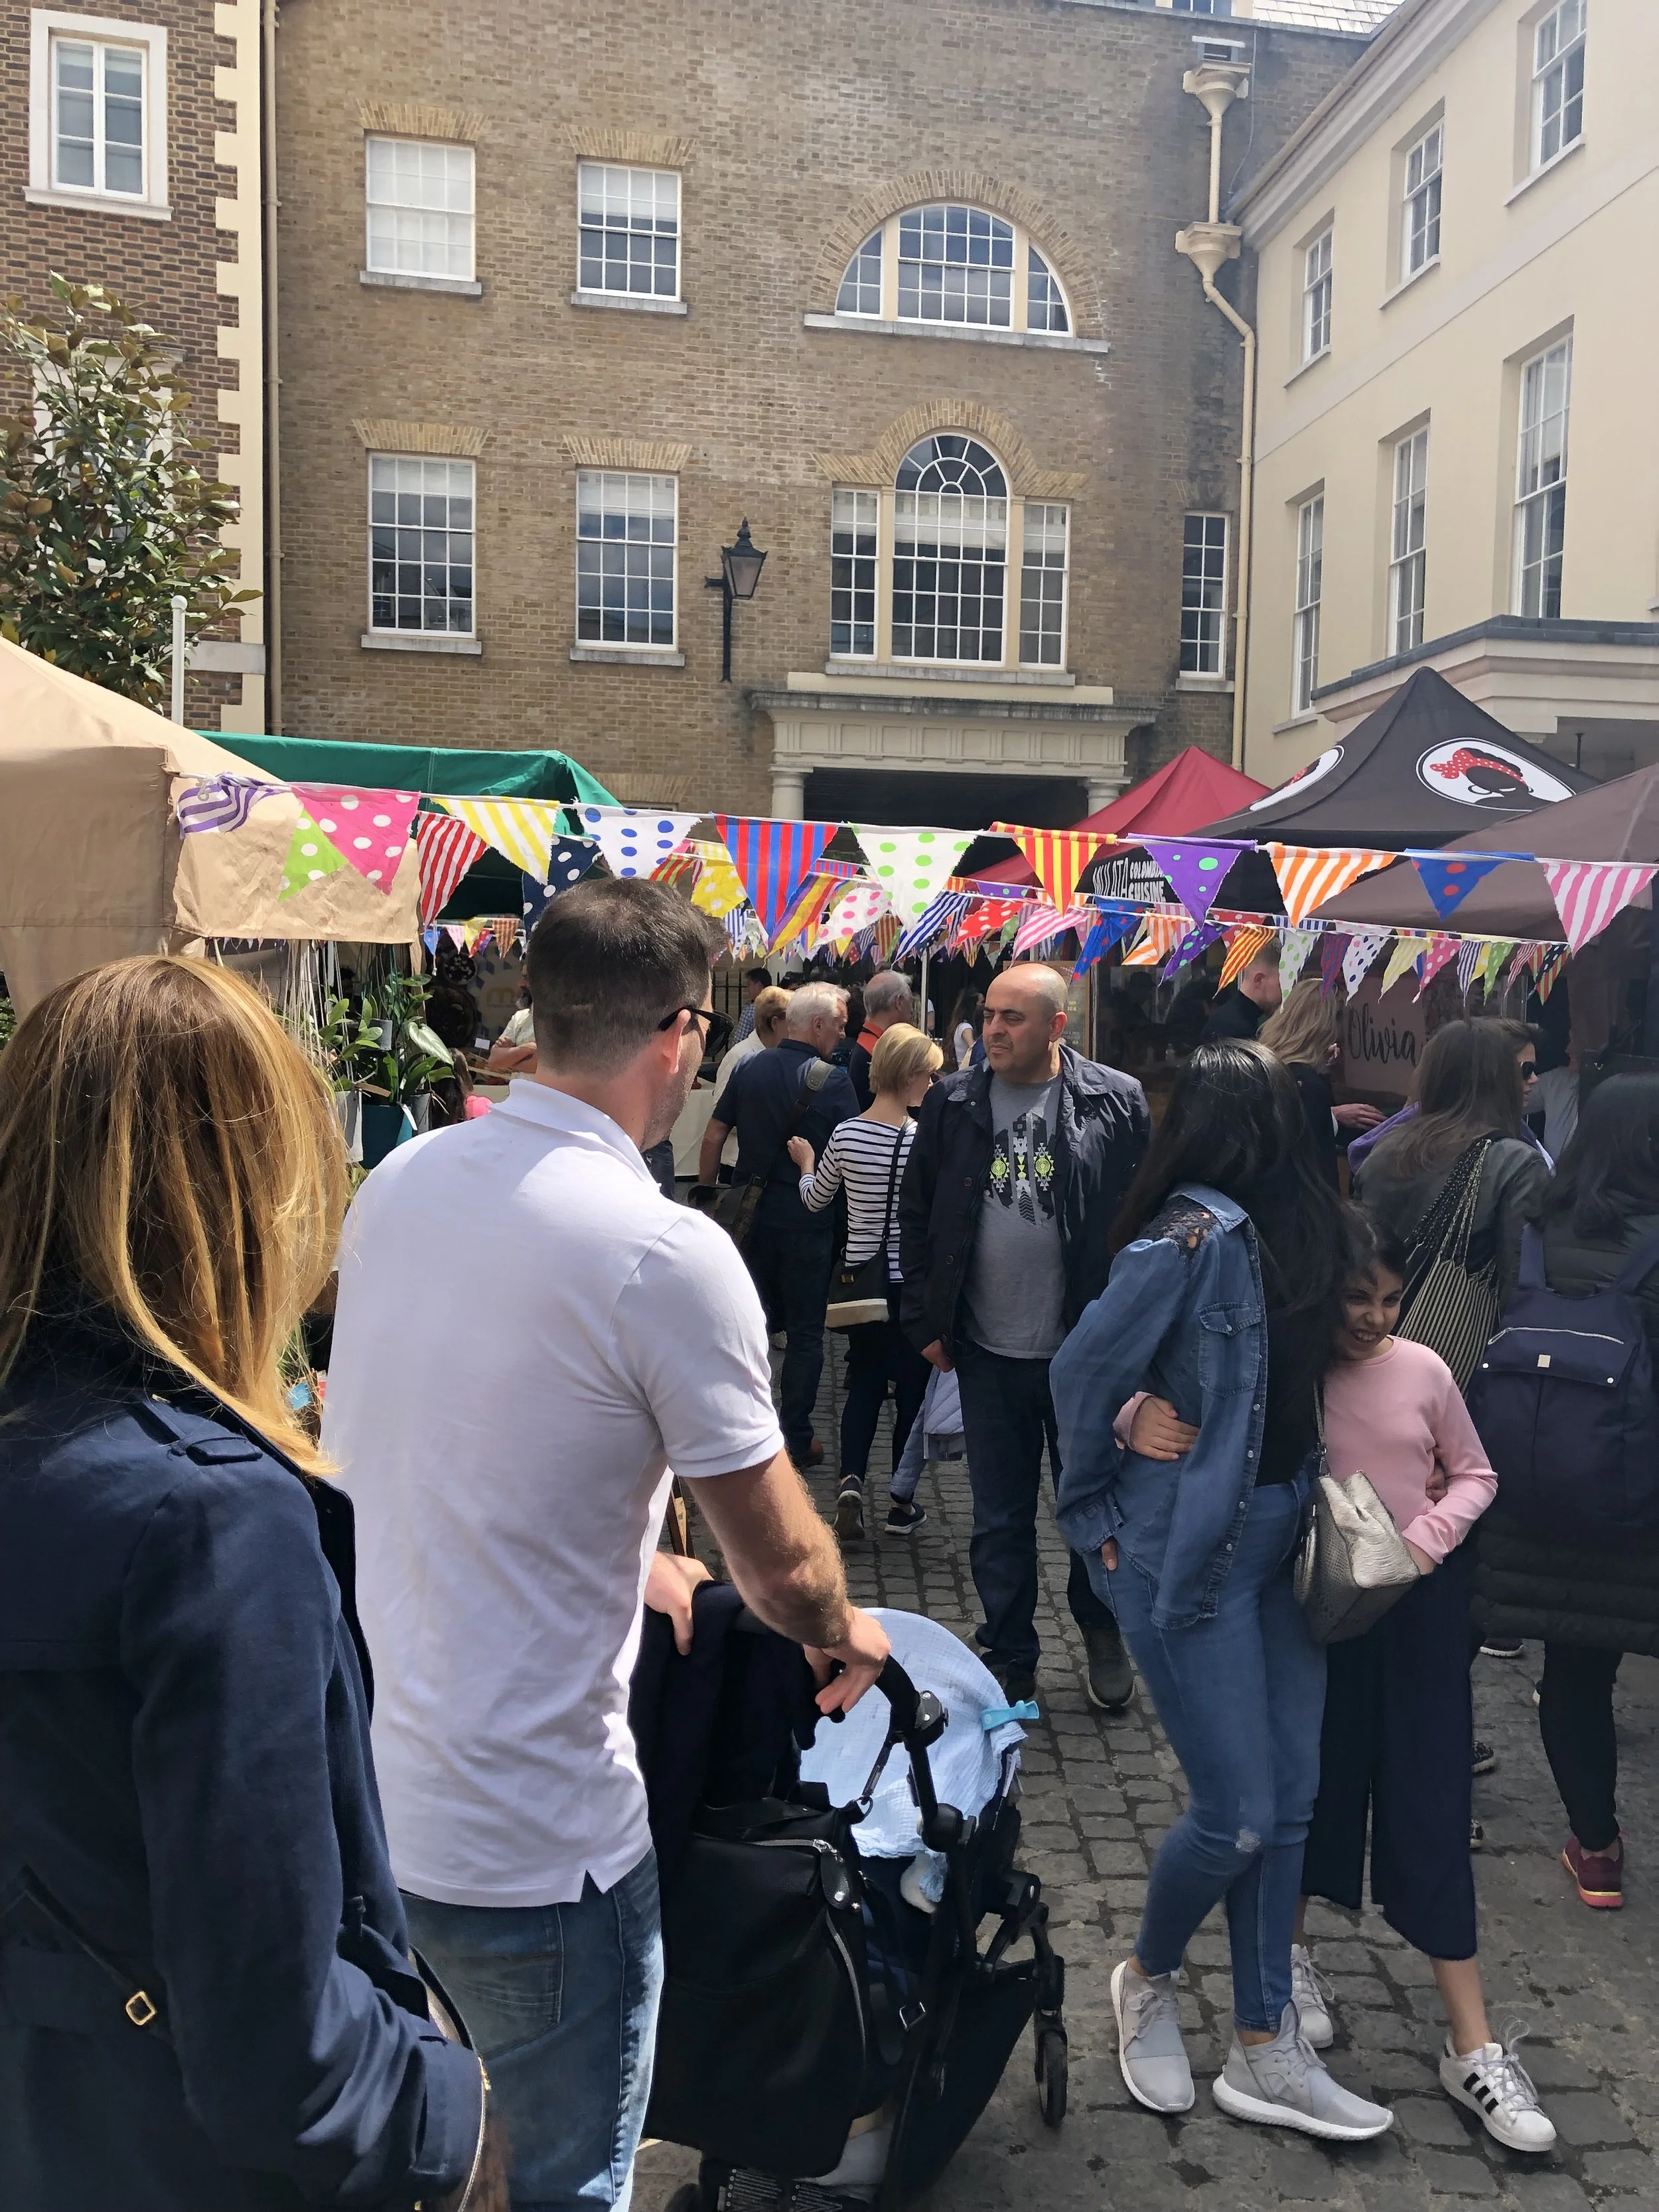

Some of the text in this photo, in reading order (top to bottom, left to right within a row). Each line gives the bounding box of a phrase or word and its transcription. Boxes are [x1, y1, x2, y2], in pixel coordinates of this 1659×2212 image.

[1129, 860, 1165, 879] COLOMBIA
[1128, 881, 1167, 902] CUISINE
[1347, 1003, 1419, 1067] Olivia
